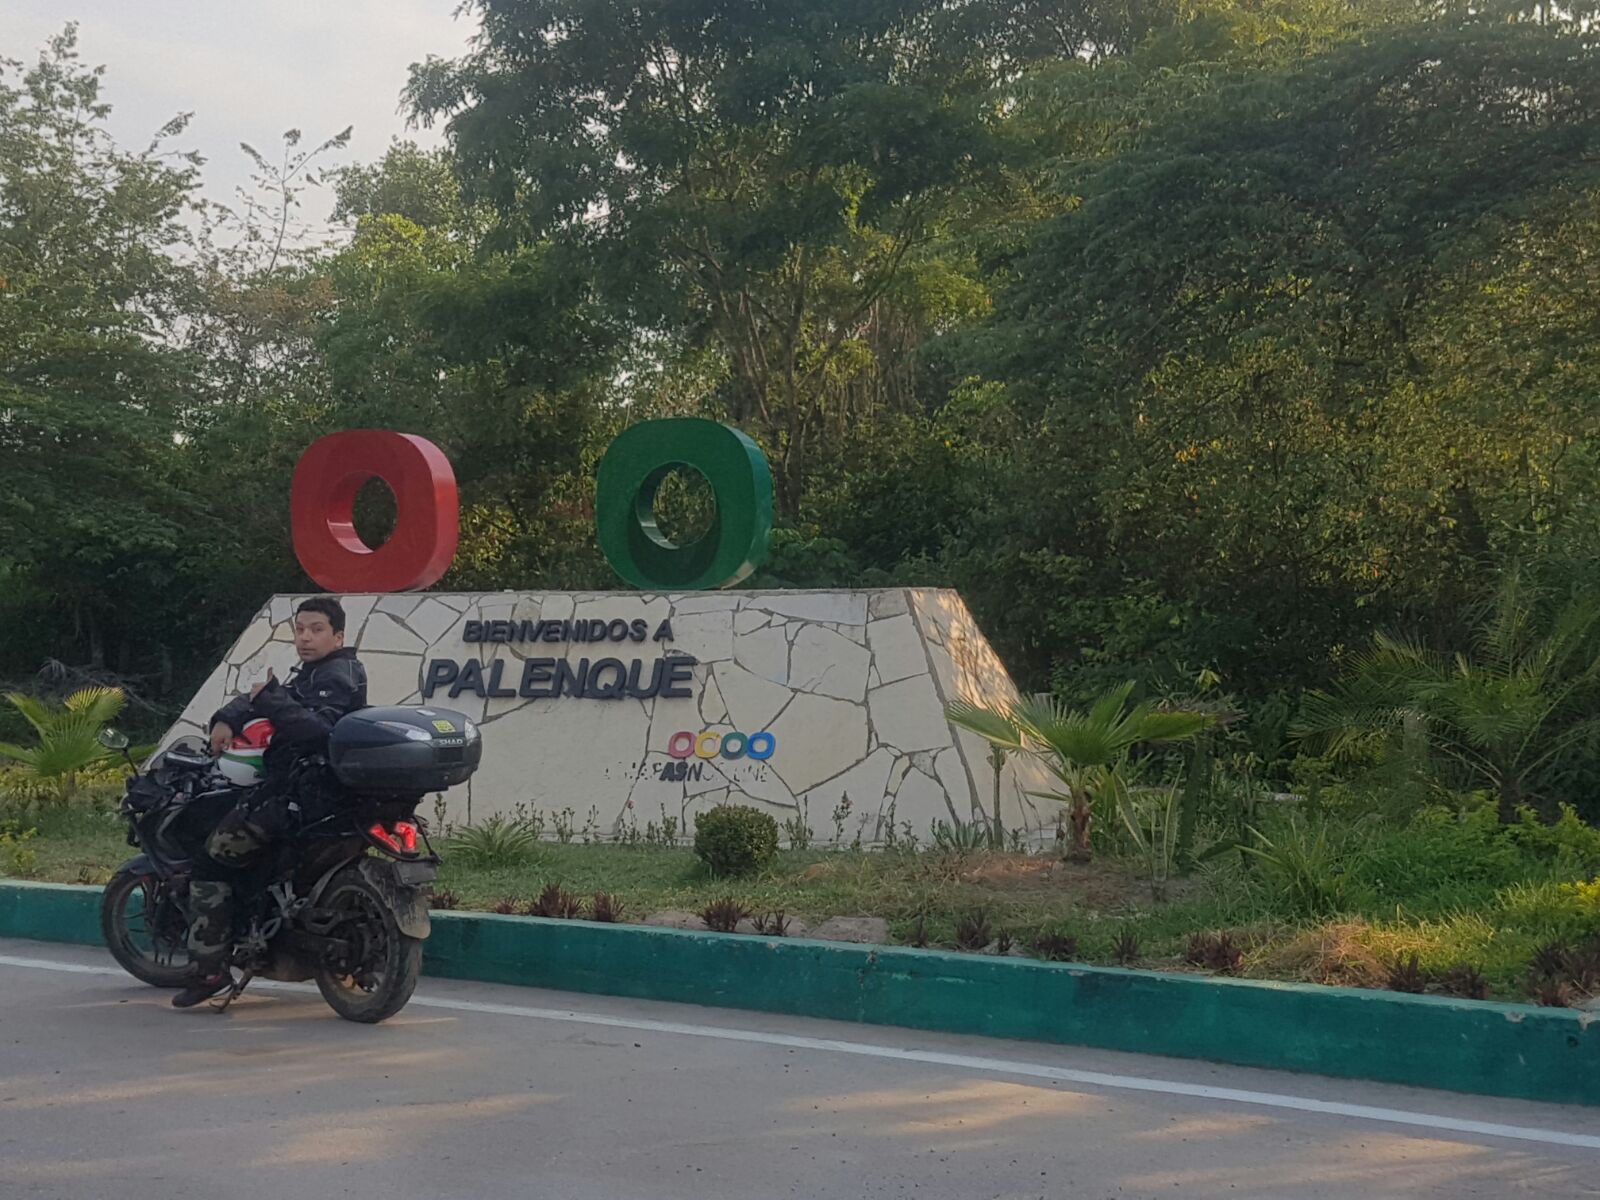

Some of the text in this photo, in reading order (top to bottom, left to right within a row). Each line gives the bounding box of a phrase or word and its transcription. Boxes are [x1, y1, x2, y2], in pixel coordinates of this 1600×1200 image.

[462, 619, 675, 643] BIENVENIDOS A
[423, 656, 698, 699] PALENQUE
